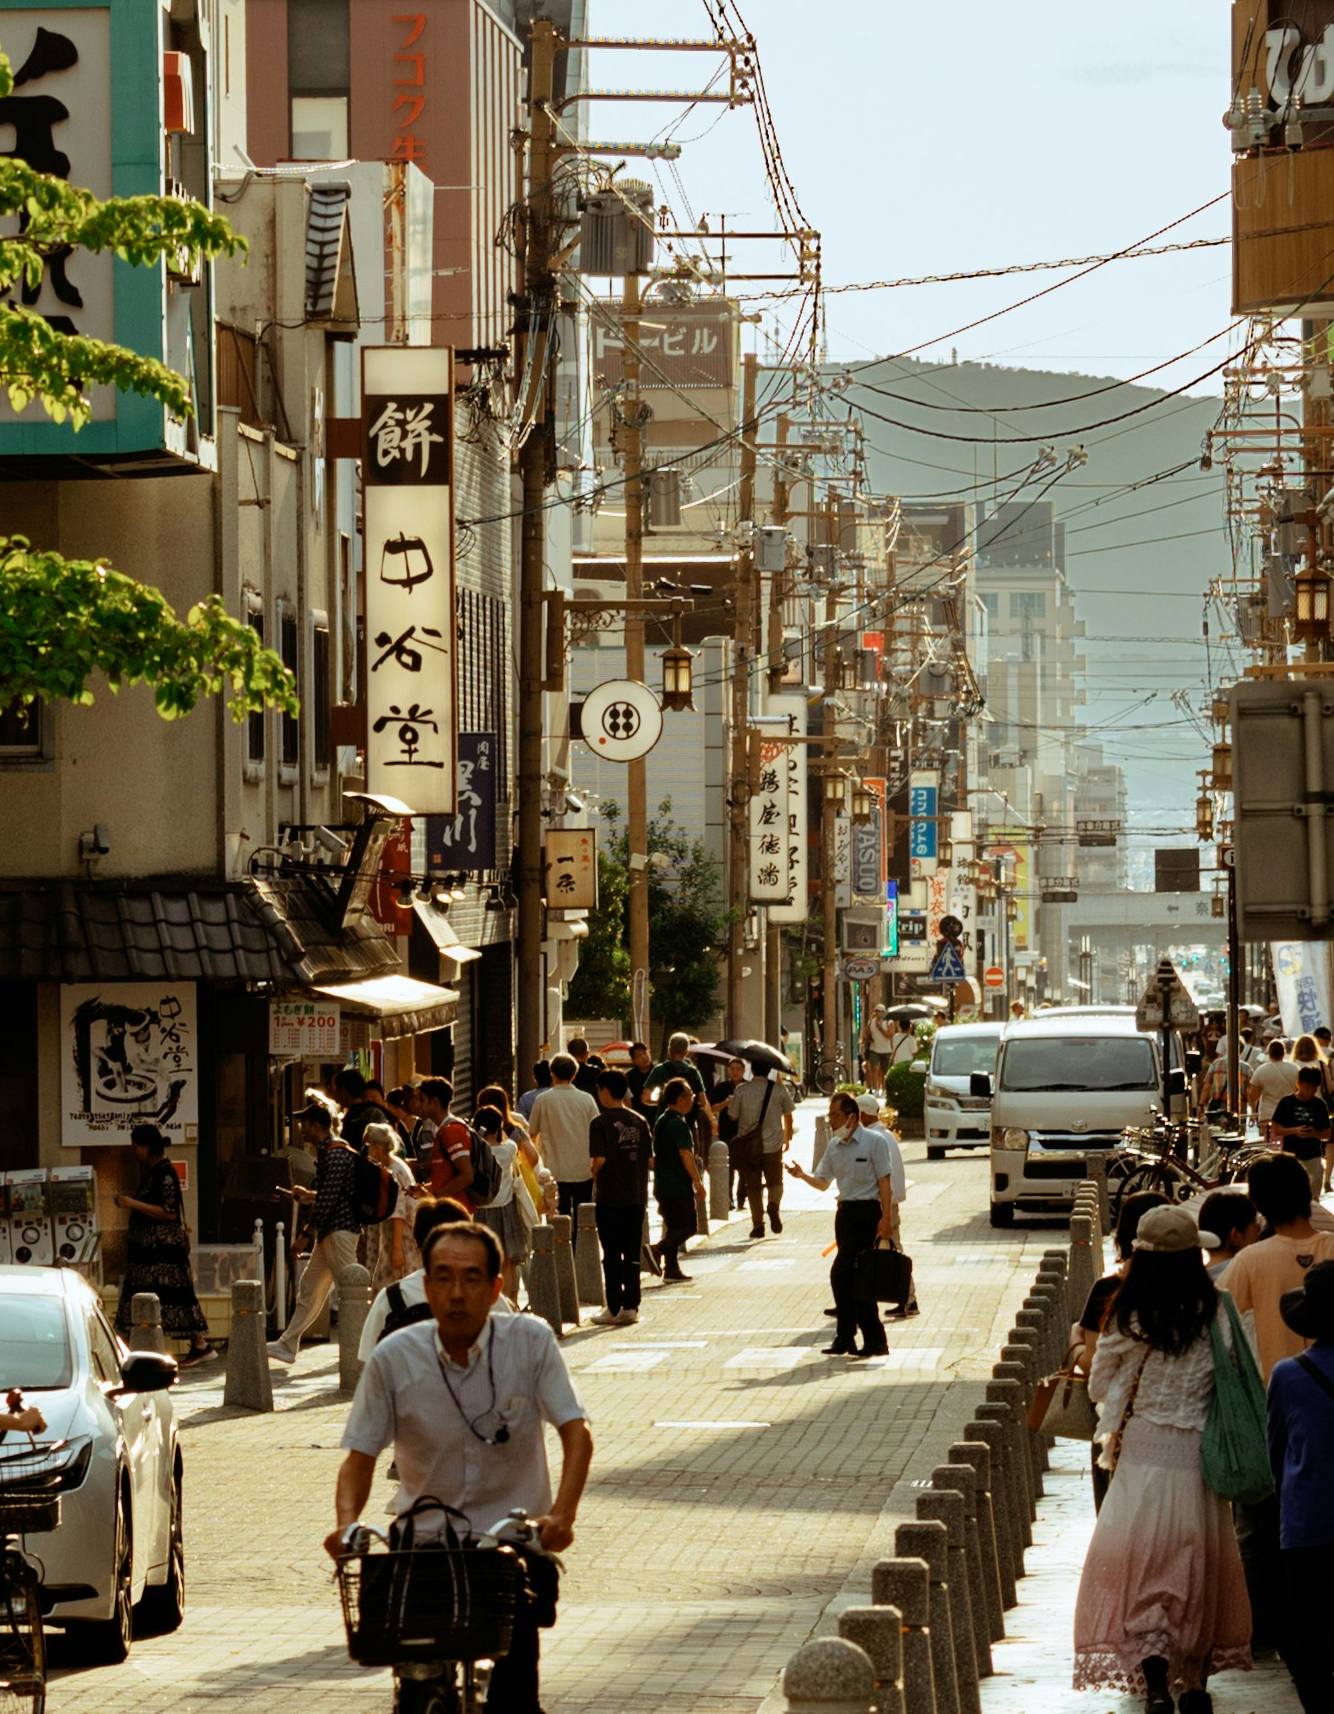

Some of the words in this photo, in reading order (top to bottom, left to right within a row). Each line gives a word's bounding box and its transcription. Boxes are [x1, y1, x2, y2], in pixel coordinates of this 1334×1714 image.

[369, 402, 444, 479] 餅
[371, 531, 448, 769] 中谷堂
